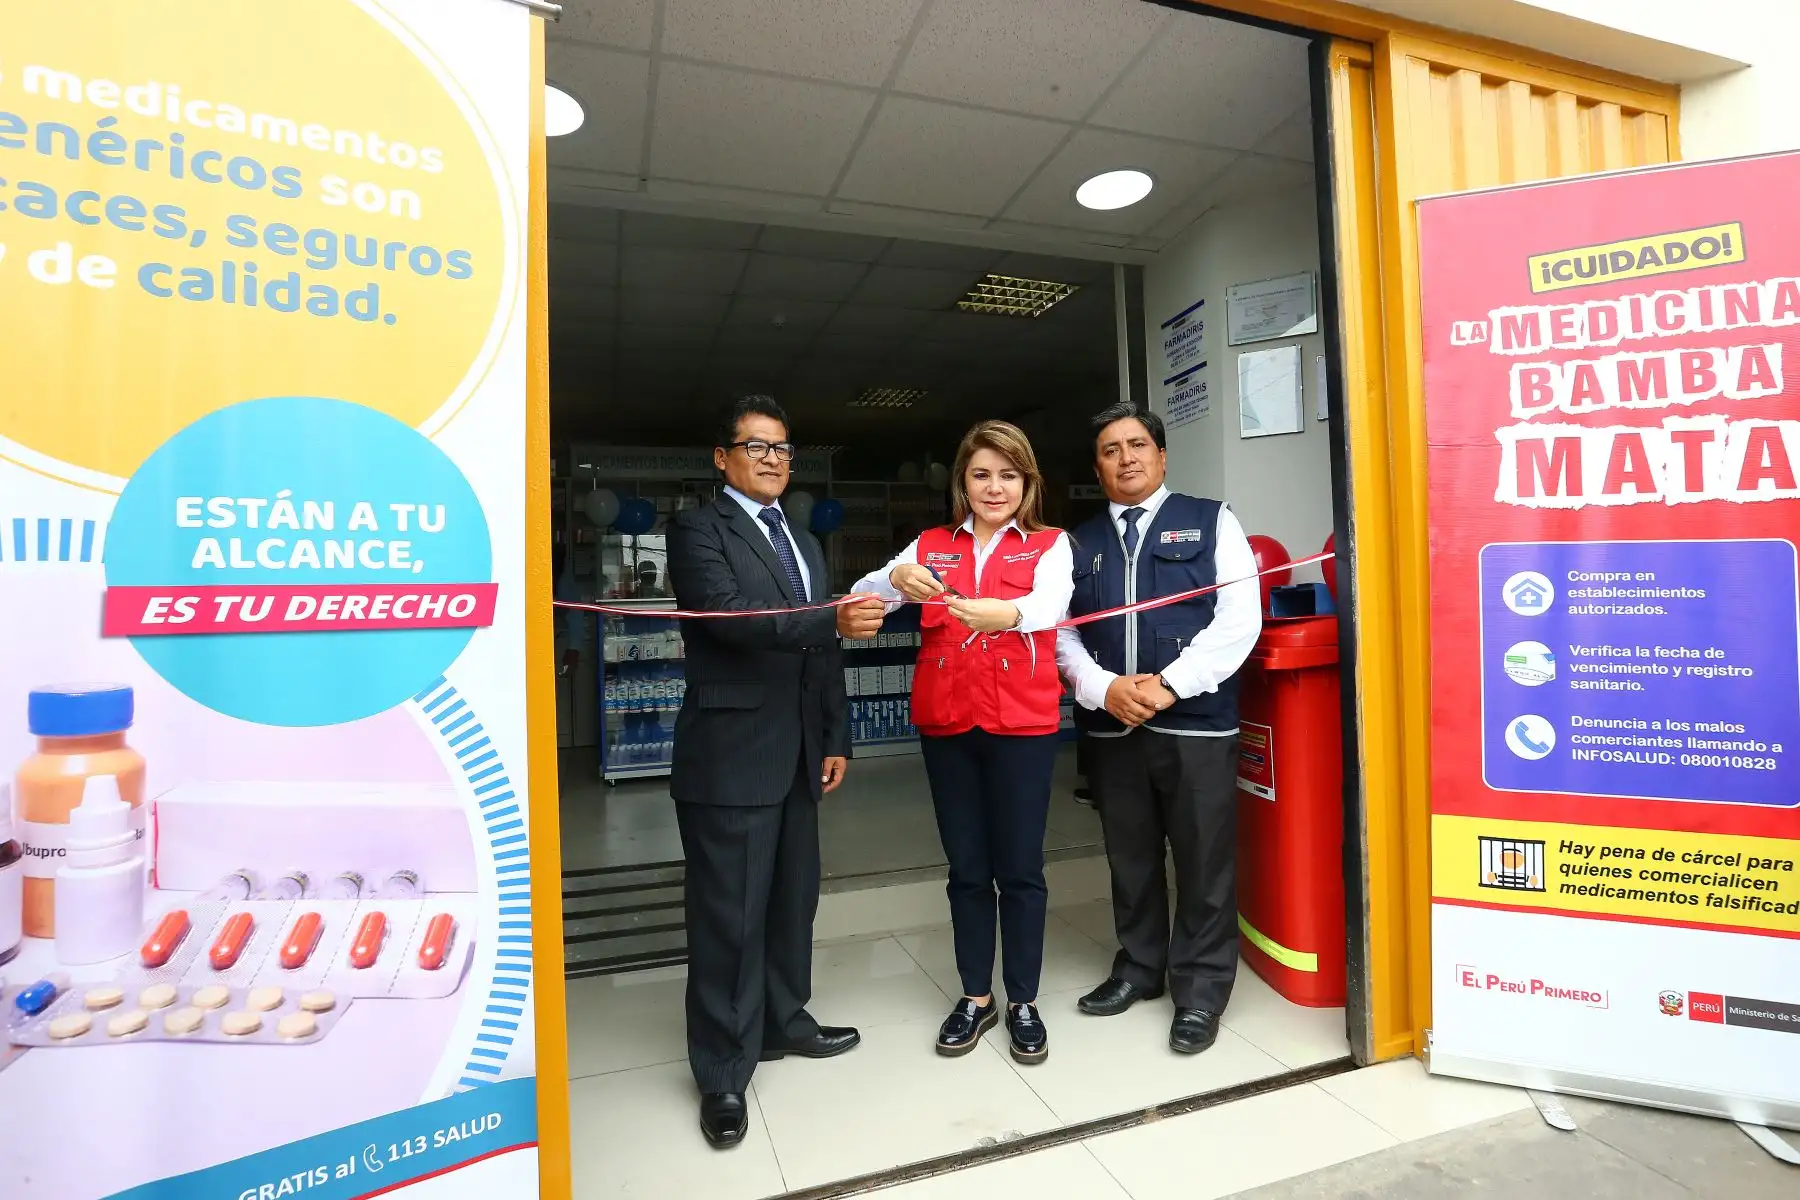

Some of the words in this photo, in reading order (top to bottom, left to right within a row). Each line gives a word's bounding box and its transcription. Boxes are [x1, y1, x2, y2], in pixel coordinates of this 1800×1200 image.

[22, 65, 444, 173] medicamentos
[319, 173, 422, 220] son
[226, 213, 473, 280] seguros
[1540, 232, 1732, 284] ¡CUIDADO!
[28, 242, 117, 288] de
[138, 260, 397, 325] calidad.
[1455, 322, 1484, 341] LA
[1500, 280, 1800, 350] MEDICINA
[1164, 321, 1204, 350] FARMADIRIS
[1167, 382, 1207, 407] FARMADIRIS
[1519, 347, 1777, 409] BAMBA
[1515, 425, 1797, 497] MATA
[176, 489, 334, 531] ESTÁN
[348, 501, 378, 532] A
[390, 503, 446, 533] TU
[191, 538, 425, 573] ALCANCE,
[1567, 570, 1631, 584] Compra
[1635, 572, 1655, 582] en
[1567, 586, 1706, 599] establecimientos
[141, 596, 200, 624] ES
[213, 595, 274, 622] TU
[284, 593, 477, 621] DERECHO
[1568, 603, 1668, 616] autorizados.
[1569, 645, 1632, 657] Verifica
[1635, 646, 1650, 658] la
[1654, 646, 1700, 659] fecha
[1704, 647, 1725, 659] de
[1570, 662, 1669, 676] vencimiento
[1672, 666, 1682, 678] y
[1686, 664, 1753, 680] registro
[1570, 679, 1645, 691] sanitario.
[1571, 715, 1647, 730] Denuncia
[1651, 721, 1662, 731] a
[1666, 719, 1689, 732] los
[1695, 720, 1745, 733] malos
[1571, 733, 1683, 748] comerciantes
[1687, 737, 1767, 753] llamando
[1771, 743, 1783, 753] a
[1572, 748, 1676, 765] INFOSALUD:
[1680, 754, 1777, 770] 080010828
[1559, 839, 1595, 859] Hay
[1599, 845, 1645, 860] pena
[1651, 846, 1676, 862] de
[1681, 849, 1741, 867] cárcel
[1746, 857, 1794, 872] para
[1559, 859, 1633, 879] quienes
[1638, 866, 1779, 892] comercialicen
[1559, 881, 1699, 906] medicamentos
[1706, 892, 1800, 915] falsificad
[1692, 1001, 1720, 1013] PERÚ
[1729, 1006, 1775, 1020] Ministerio
[1777, 1012, 1790, 1021] de
[238, 1165, 328, 1200] GRATIS
[335, 1155, 356, 1179] al
[387, 1135, 427, 1162] 113
[433, 1112, 502, 1148] SALUD
